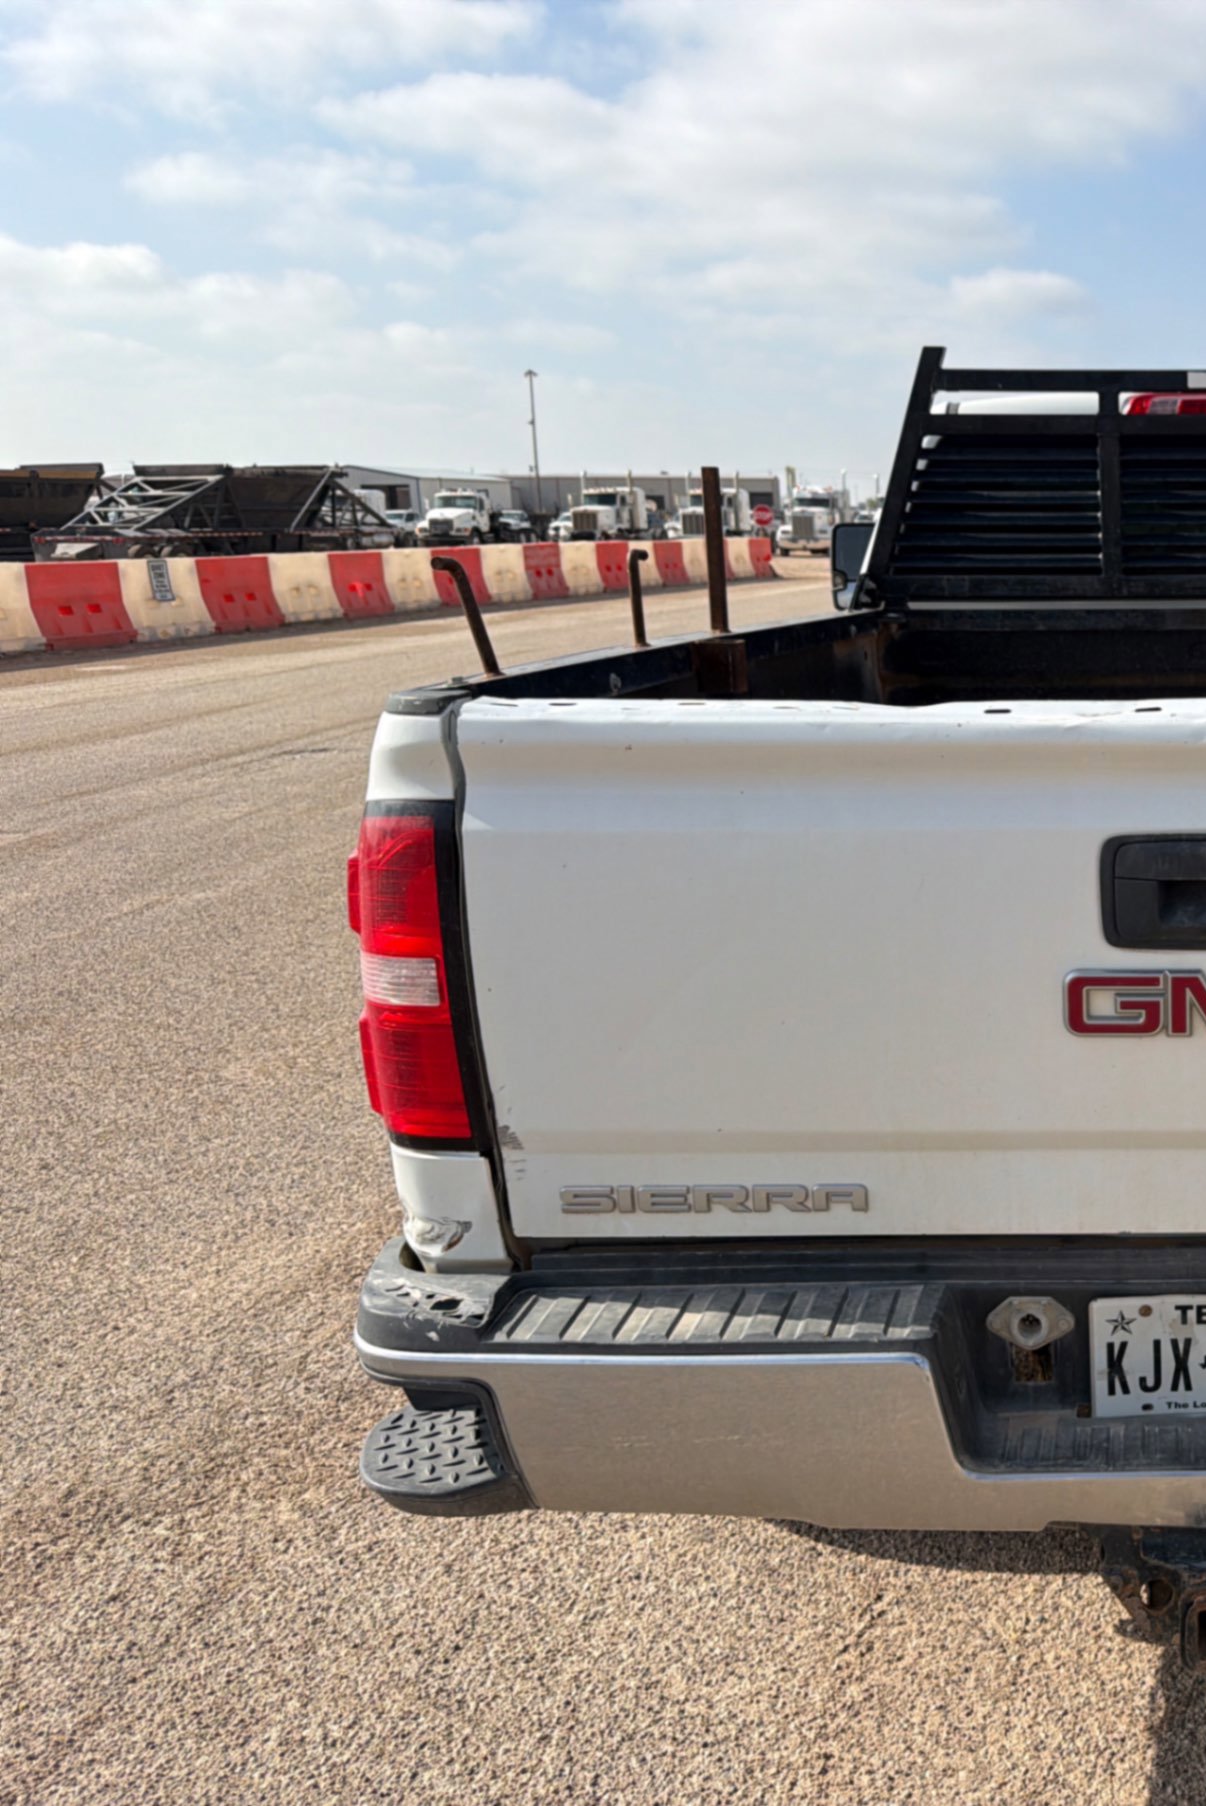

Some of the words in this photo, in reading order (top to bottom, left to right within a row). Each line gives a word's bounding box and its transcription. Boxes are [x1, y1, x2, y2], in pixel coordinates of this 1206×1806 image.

[559, 1183, 869, 1213] SIERRA
[1106, 1337, 1193, 1396] KJX
[1166, 1401, 1189, 1409] The
